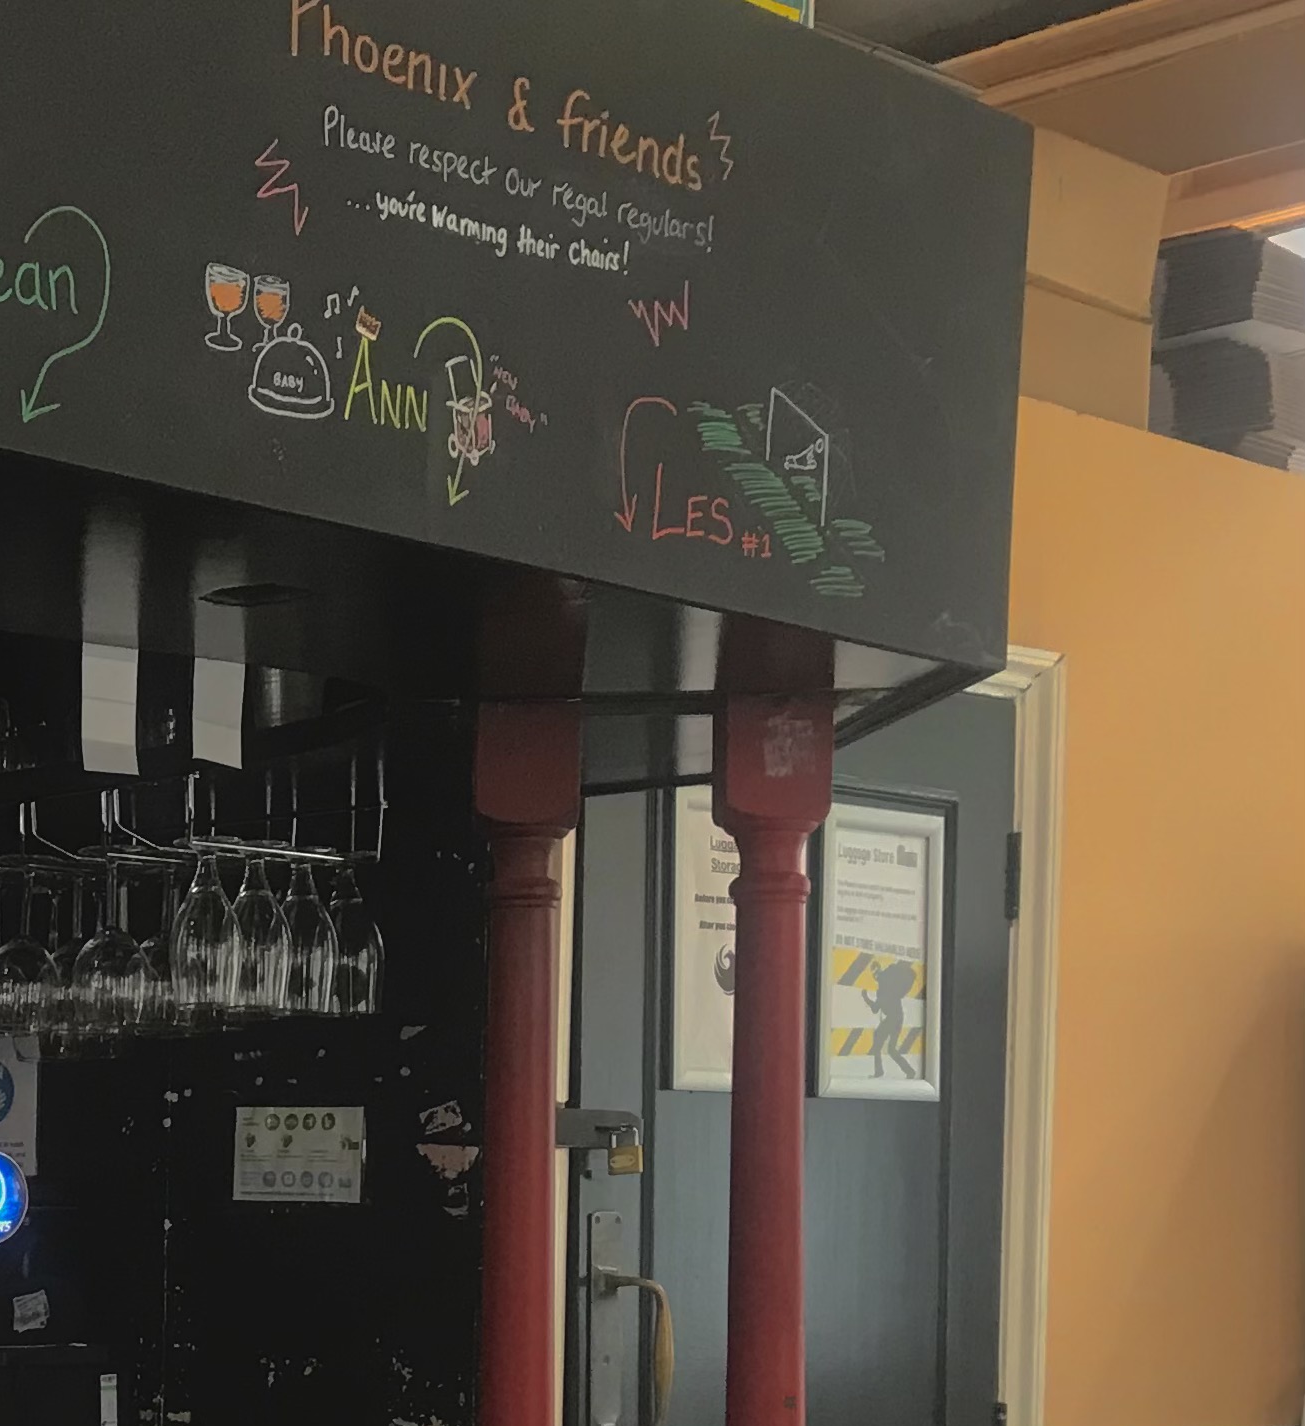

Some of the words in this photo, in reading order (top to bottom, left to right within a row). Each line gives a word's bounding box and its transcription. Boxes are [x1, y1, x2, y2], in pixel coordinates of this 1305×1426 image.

[507, 77, 535, 132] &
[556, 89, 702, 191] friends
[323, 103, 396, 158] Please
[409, 141, 497, 185] respect
[552, 183, 607, 227] regal
[617, 202, 715, 253] regulars!
[518, 223, 560, 260] their
[273, 371, 303, 393] BABY
[652, 462, 733, 545] LES
[741, 530, 772, 558] #1
[710, 836, 738, 851] Lugg
[711, 858, 740, 872] Stora
